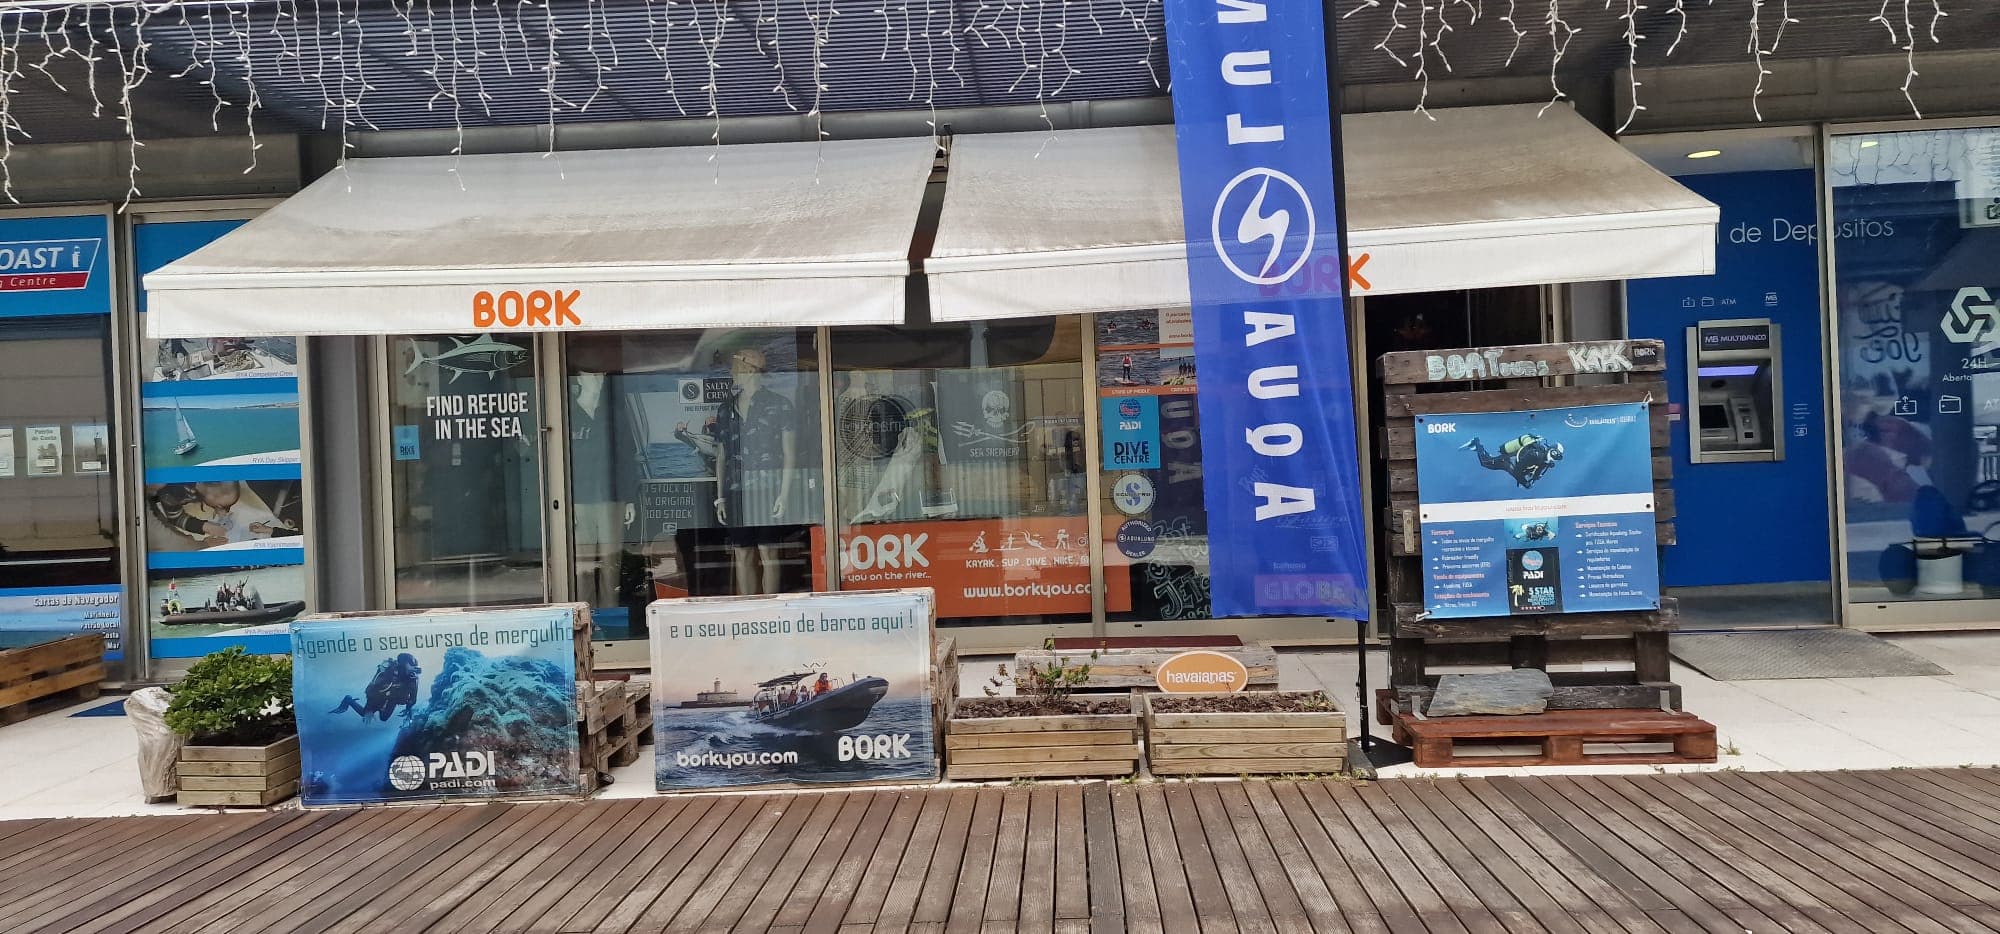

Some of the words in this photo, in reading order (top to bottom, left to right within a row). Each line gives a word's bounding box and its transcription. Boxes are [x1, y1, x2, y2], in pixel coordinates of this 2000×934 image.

[1729, 221, 1762, 244] de
[10, 276, 57, 287] Centre
[472, 289, 582, 328] BORK
[1720, 333, 1767, 343] MULTIBANCO
[706, 381, 730, 390] SALTY
[706, 391, 729, 399] CREW
[426, 395, 464, 417] FIND
[467, 392, 529, 415] REFUGE
[435, 418, 452, 440] IN
[455, 418, 487, 439] THE
[491, 416, 522, 438] SEA
[1120, 421, 1141, 430] PADI
[1427, 422, 1456, 434] BORK
[969, 448, 984, 457] SEA
[1113, 441, 1149, 456] DIVE
[1114, 454, 1150, 464] CENTRE
[965, 559, 995, 569] KAYAK
[1001, 558, 1020, 568] SUP
[1026, 556, 1047, 567] DIVE
[1053, 555, 1073, 566] HIKE
[848, 573, 868, 583] you
[869, 573, 883, 581] on
[884, 571, 903, 580] the
[1522, 571, 1545, 580] PADI
[963, 582, 1108, 598] www.borkyou.co
[1534, 586, 1555, 596] STAR
[33, 597, 60, 607] Cartas
[62, 596, 73, 606] de
[74, 593, 120, 606] Navegador
[670, 624, 679, 639] e
[684, 624, 694, 638] o
[699, 623, 726, 638] seu
[732, 616, 791, 640] passeio
[797, 613, 815, 633] de
[820, 611, 866, 632] barco
[871, 611, 903, 636] aqui
[298, 631, 358, 660] Agende
[363, 636, 374, 651] o
[379, 634, 408, 651] seu
[414, 631, 463, 649] curso
[470, 623, 489, 647] de
[495, 619, 575, 648] mergulho
[1166, 669, 1236, 685] havaianas
[837, 733, 912, 762] BORK
[428, 750, 496, 779] PADI
[675, 750, 798, 769] borkyou.com
[429, 777, 496, 791] padi.com
